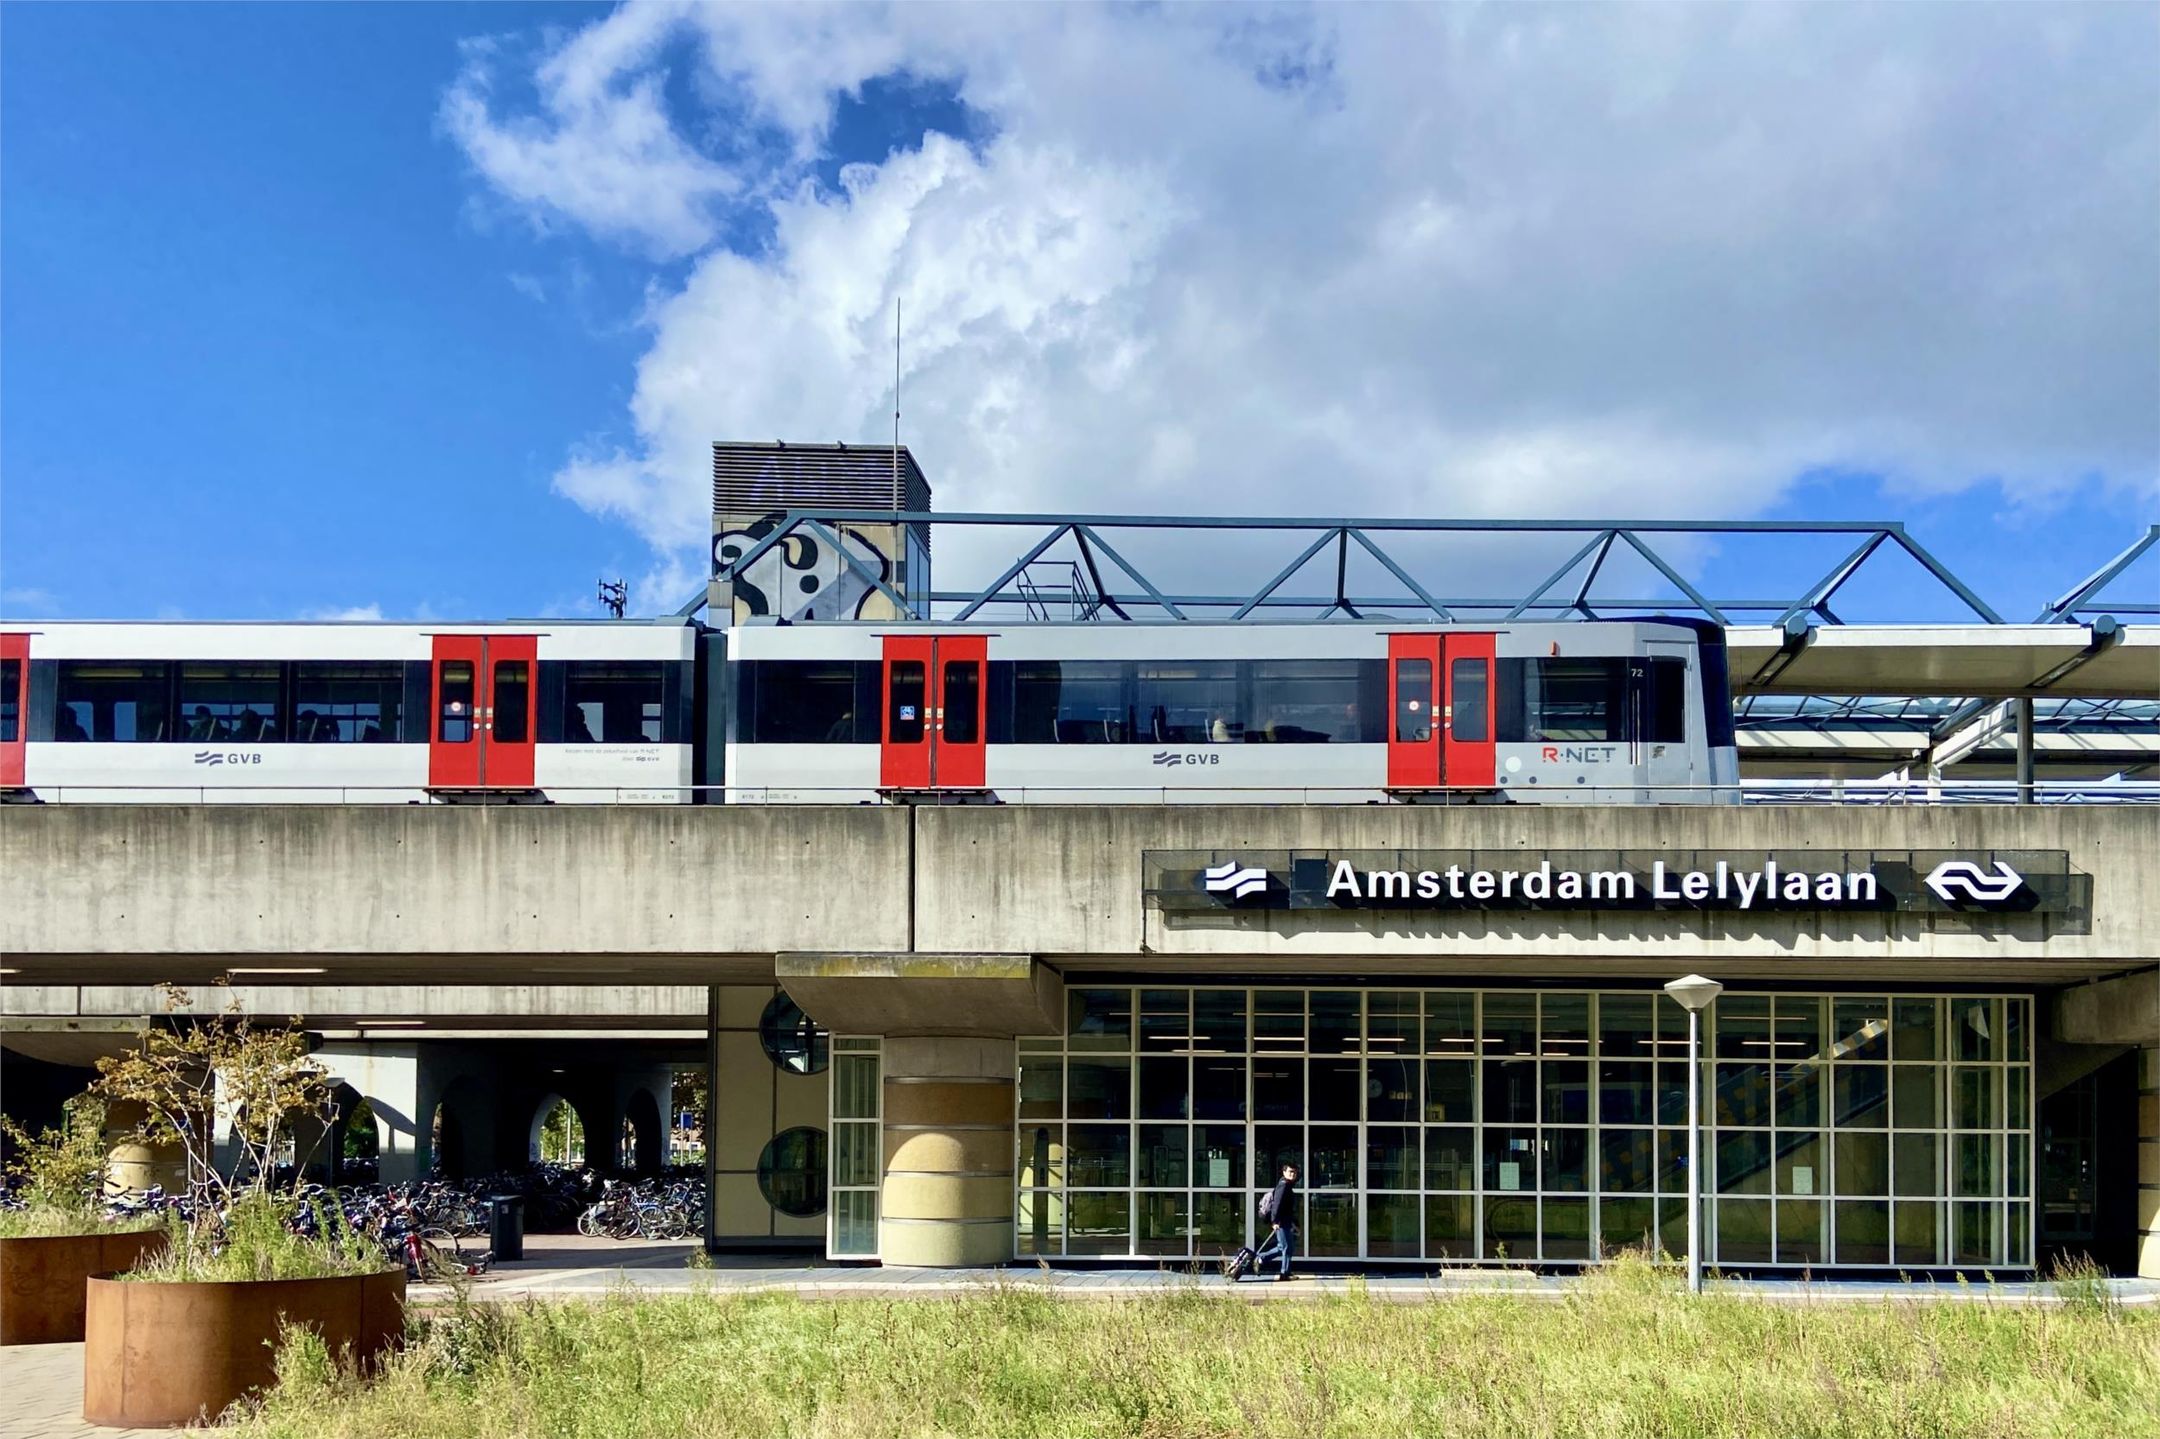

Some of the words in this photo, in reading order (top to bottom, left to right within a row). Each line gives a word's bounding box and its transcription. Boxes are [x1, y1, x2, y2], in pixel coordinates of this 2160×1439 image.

[1631, 668, 1644, 677] 72
[227, 753, 261, 764] GVB
[1185, 754, 1219, 765] GVB
[1326, 860, 1635, 900] Amsterdam
[1652, 860, 1877, 909] Lelylaan
